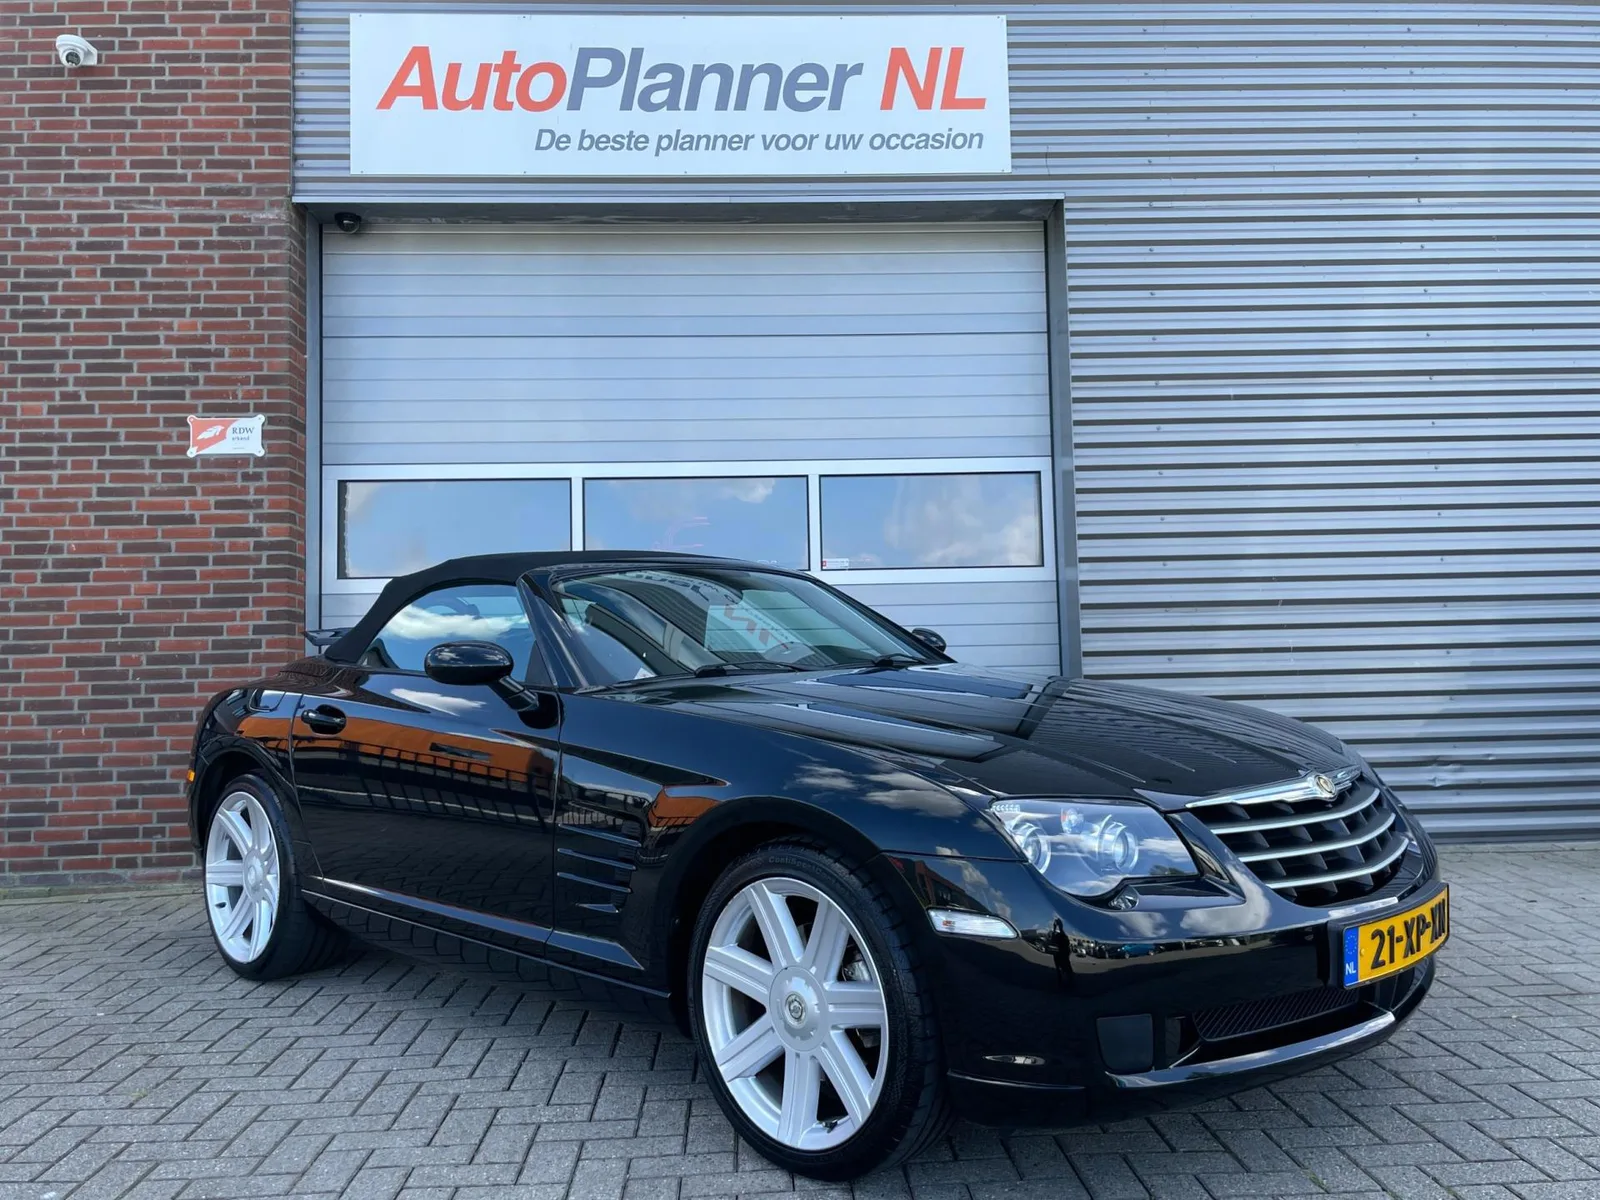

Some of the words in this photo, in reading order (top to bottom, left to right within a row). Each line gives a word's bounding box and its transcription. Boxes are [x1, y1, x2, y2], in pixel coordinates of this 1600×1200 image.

[376, 46, 864, 112] AutoPlanner
[880, 47, 986, 110] NL
[535, 128, 571, 151] De
[577, 128, 650, 151] beste
[654, 128, 755, 157] planner
[761, 133, 820, 151] voor
[825, 132, 864, 151] uw
[869, 127, 984, 151] occasion
[232, 426, 255, 435] RDW
[1370, 898, 1446, 970] 21-XP-XN
[1345, 961, 1356, 975] NL
